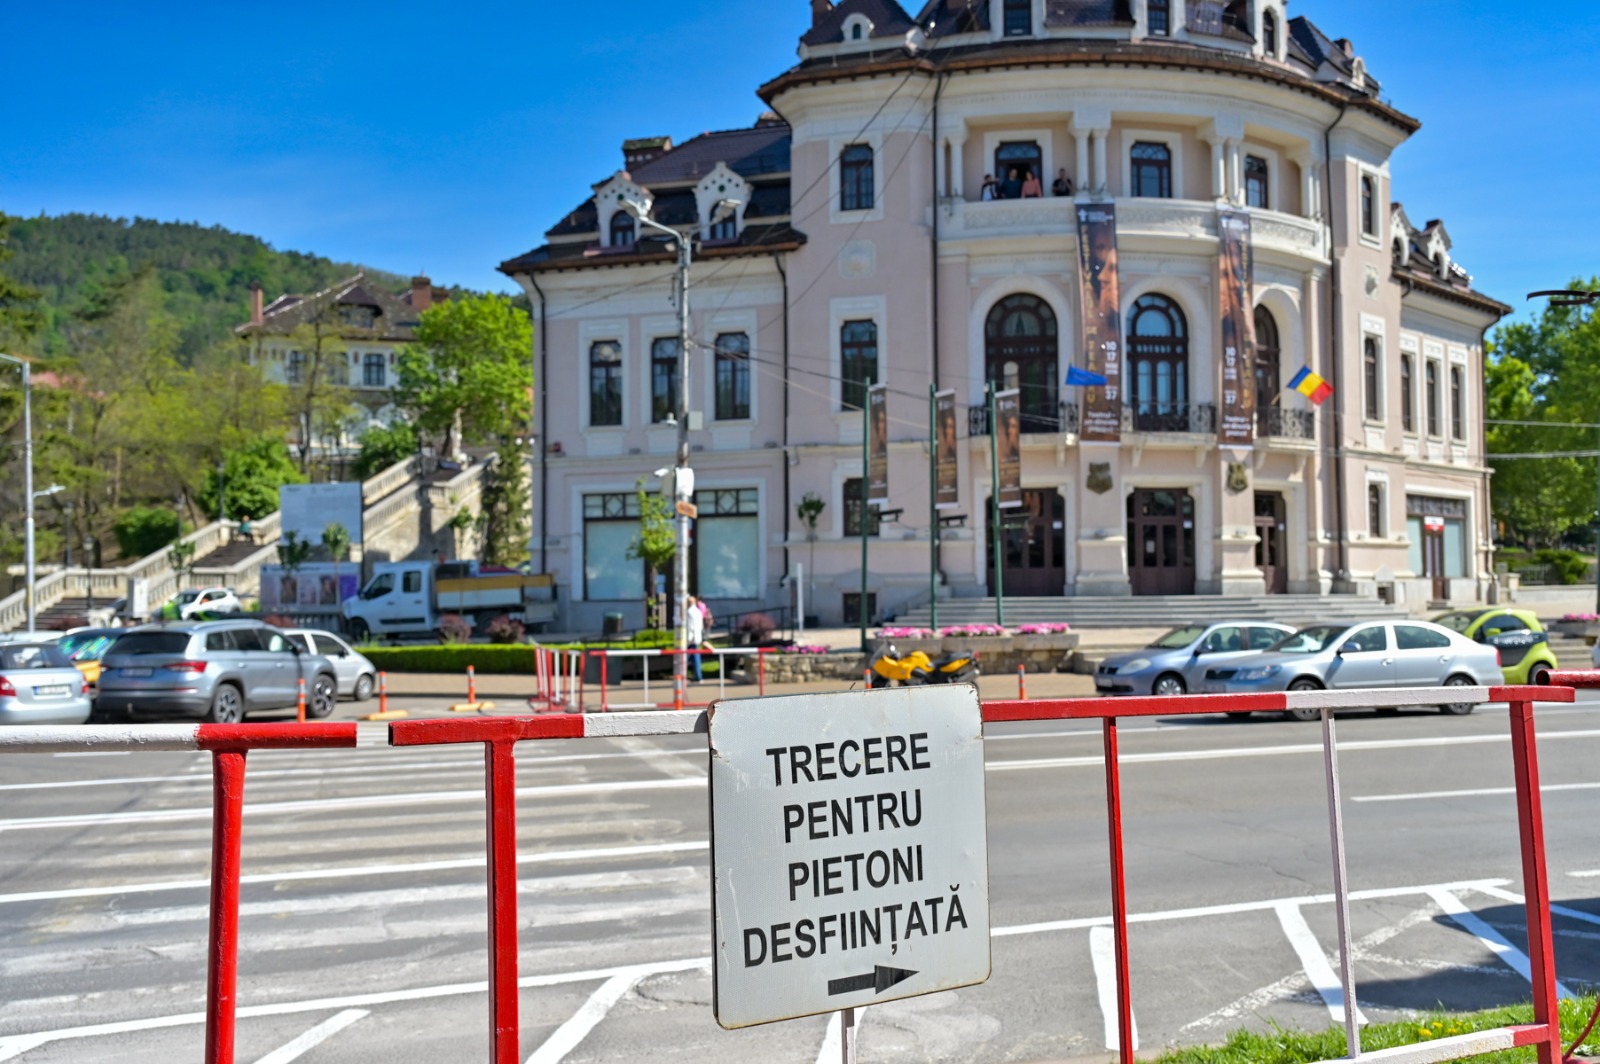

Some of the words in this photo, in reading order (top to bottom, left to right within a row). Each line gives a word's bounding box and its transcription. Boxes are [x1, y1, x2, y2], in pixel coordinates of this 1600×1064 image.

[766, 732, 931, 787] TRECERE
[784, 789, 922, 844] PENTRU
[788, 844, 924, 901] PIETONI
[743, 883, 968, 968] DESFIINȚATĂ
